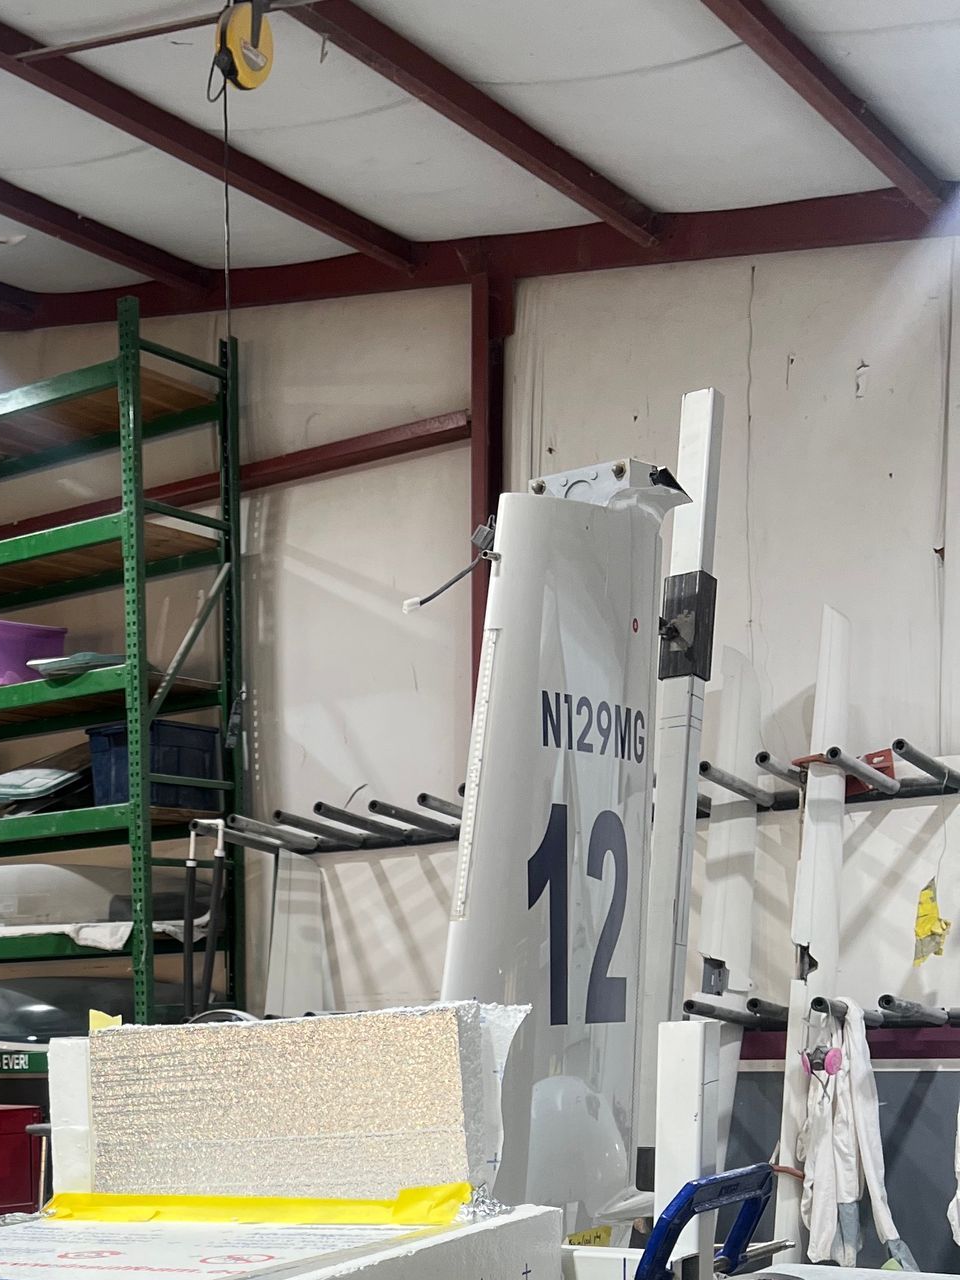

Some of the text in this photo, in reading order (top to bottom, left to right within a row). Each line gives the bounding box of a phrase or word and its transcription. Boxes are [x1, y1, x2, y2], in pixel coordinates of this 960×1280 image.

[541, 690, 645, 765] N129MG
[527, 803, 629, 1026] 12
[2, 1054, 29, 1069] EVER!
